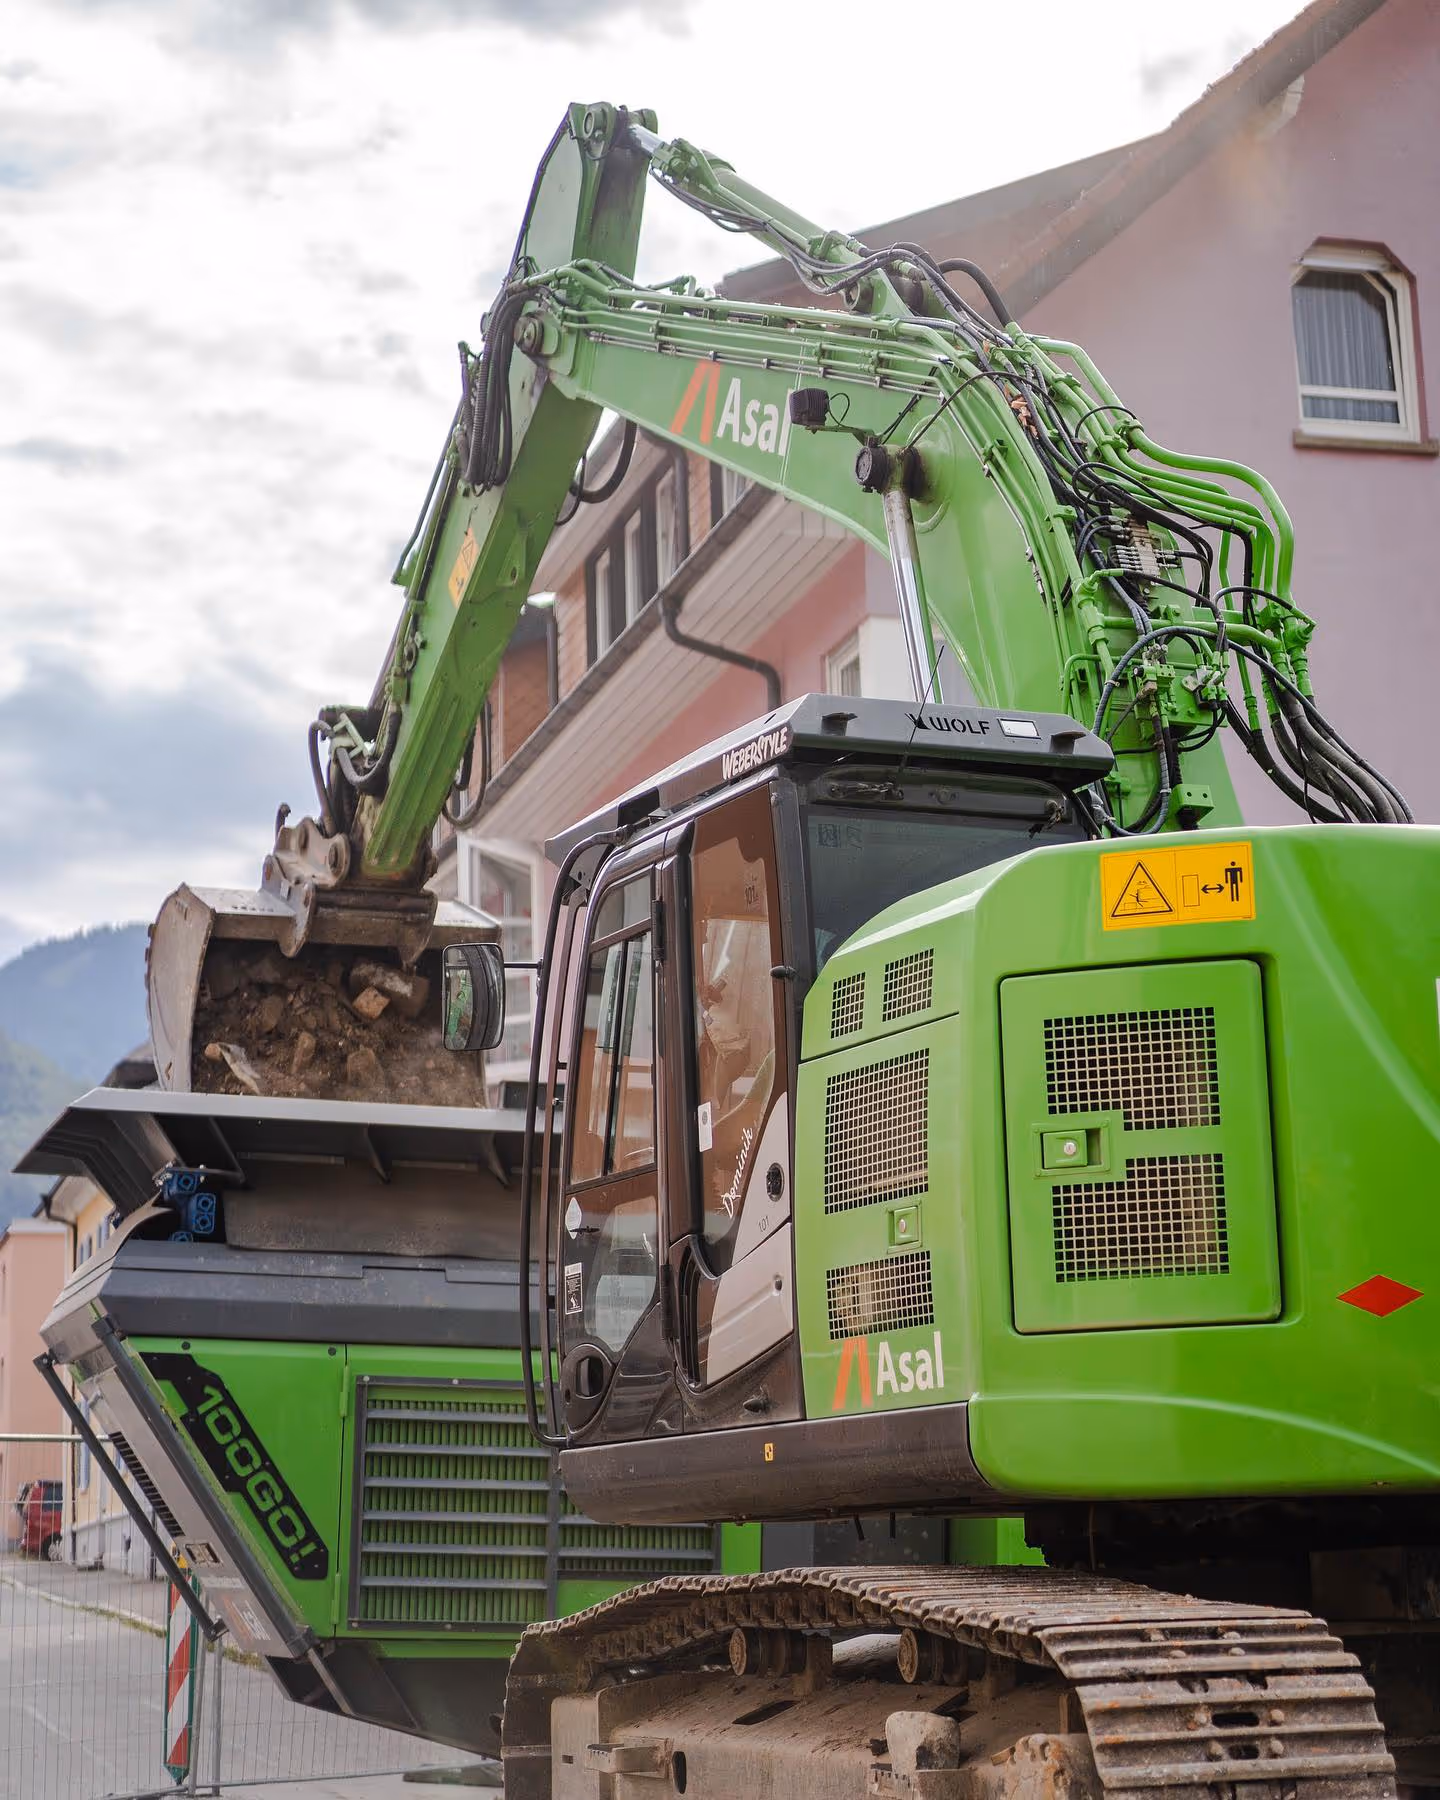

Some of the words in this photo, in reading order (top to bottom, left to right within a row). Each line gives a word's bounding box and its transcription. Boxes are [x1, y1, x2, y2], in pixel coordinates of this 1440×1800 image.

[722, 726, 788, 780] WEBERSTYLE
[928, 716, 991, 735] WOLF
[720, 1127, 753, 1219] Dominik
[876, 1330, 945, 1396] Asal
